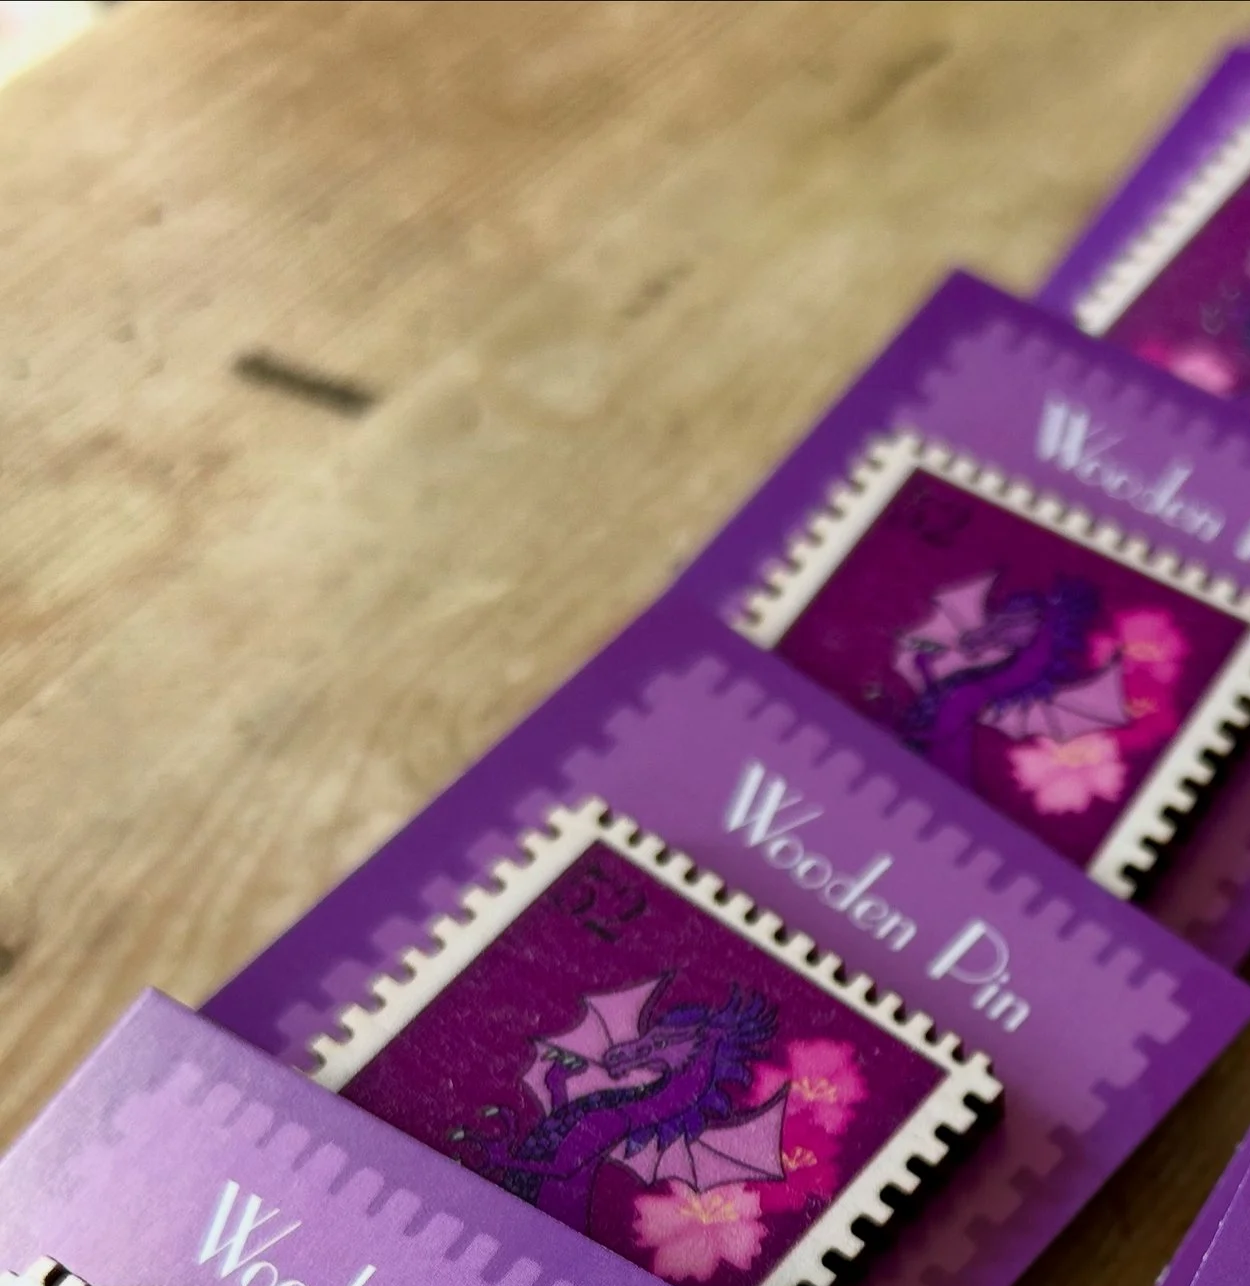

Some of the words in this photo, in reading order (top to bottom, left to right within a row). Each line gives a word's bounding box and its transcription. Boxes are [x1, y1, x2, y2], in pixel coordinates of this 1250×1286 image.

[1036, 395, 1226, 543] Wooden
[723, 759, 920, 952] Wooden
[926, 919, 1031, 1034] Pin
